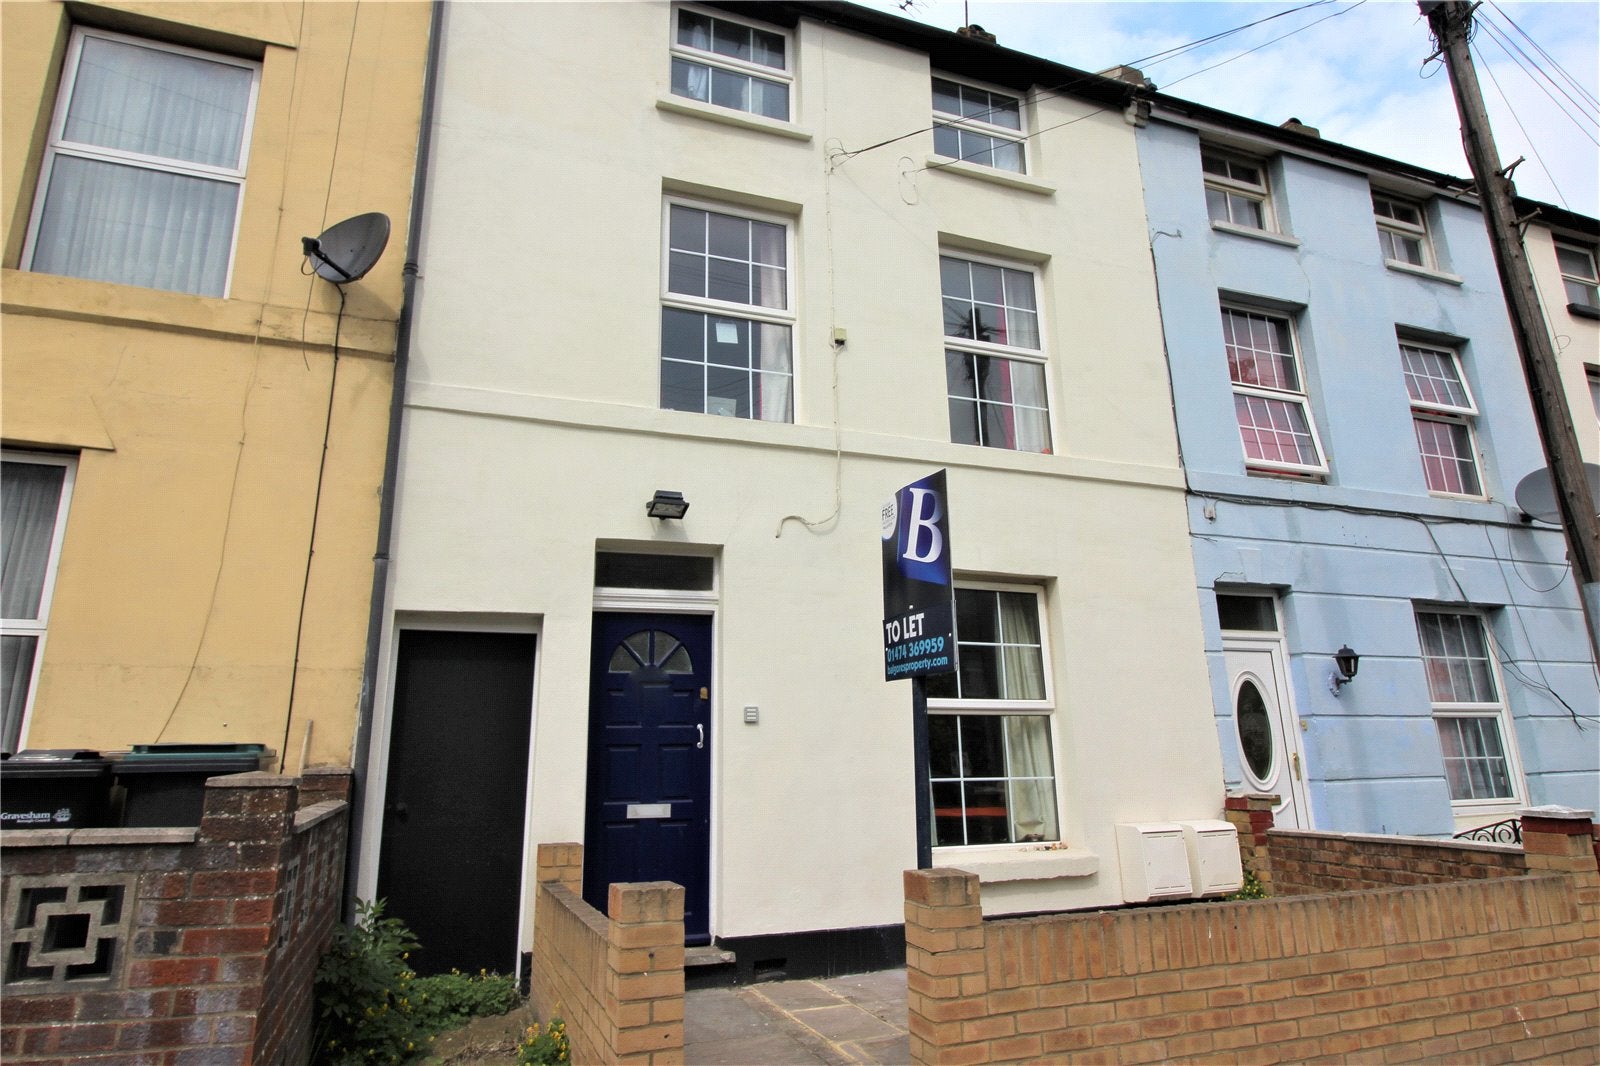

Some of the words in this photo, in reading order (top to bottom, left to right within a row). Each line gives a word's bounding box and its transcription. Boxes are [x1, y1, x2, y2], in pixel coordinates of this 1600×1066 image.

[882, 503, 894, 520] FREE
[903, 488, 943, 563] B
[886, 620, 900, 644] TO
[903, 613, 924, 639] LET
[887, 644, 907, 663] 01474
[908, 636, 945, 657] 369959
[0, 811, 51, 820] Gravesham
